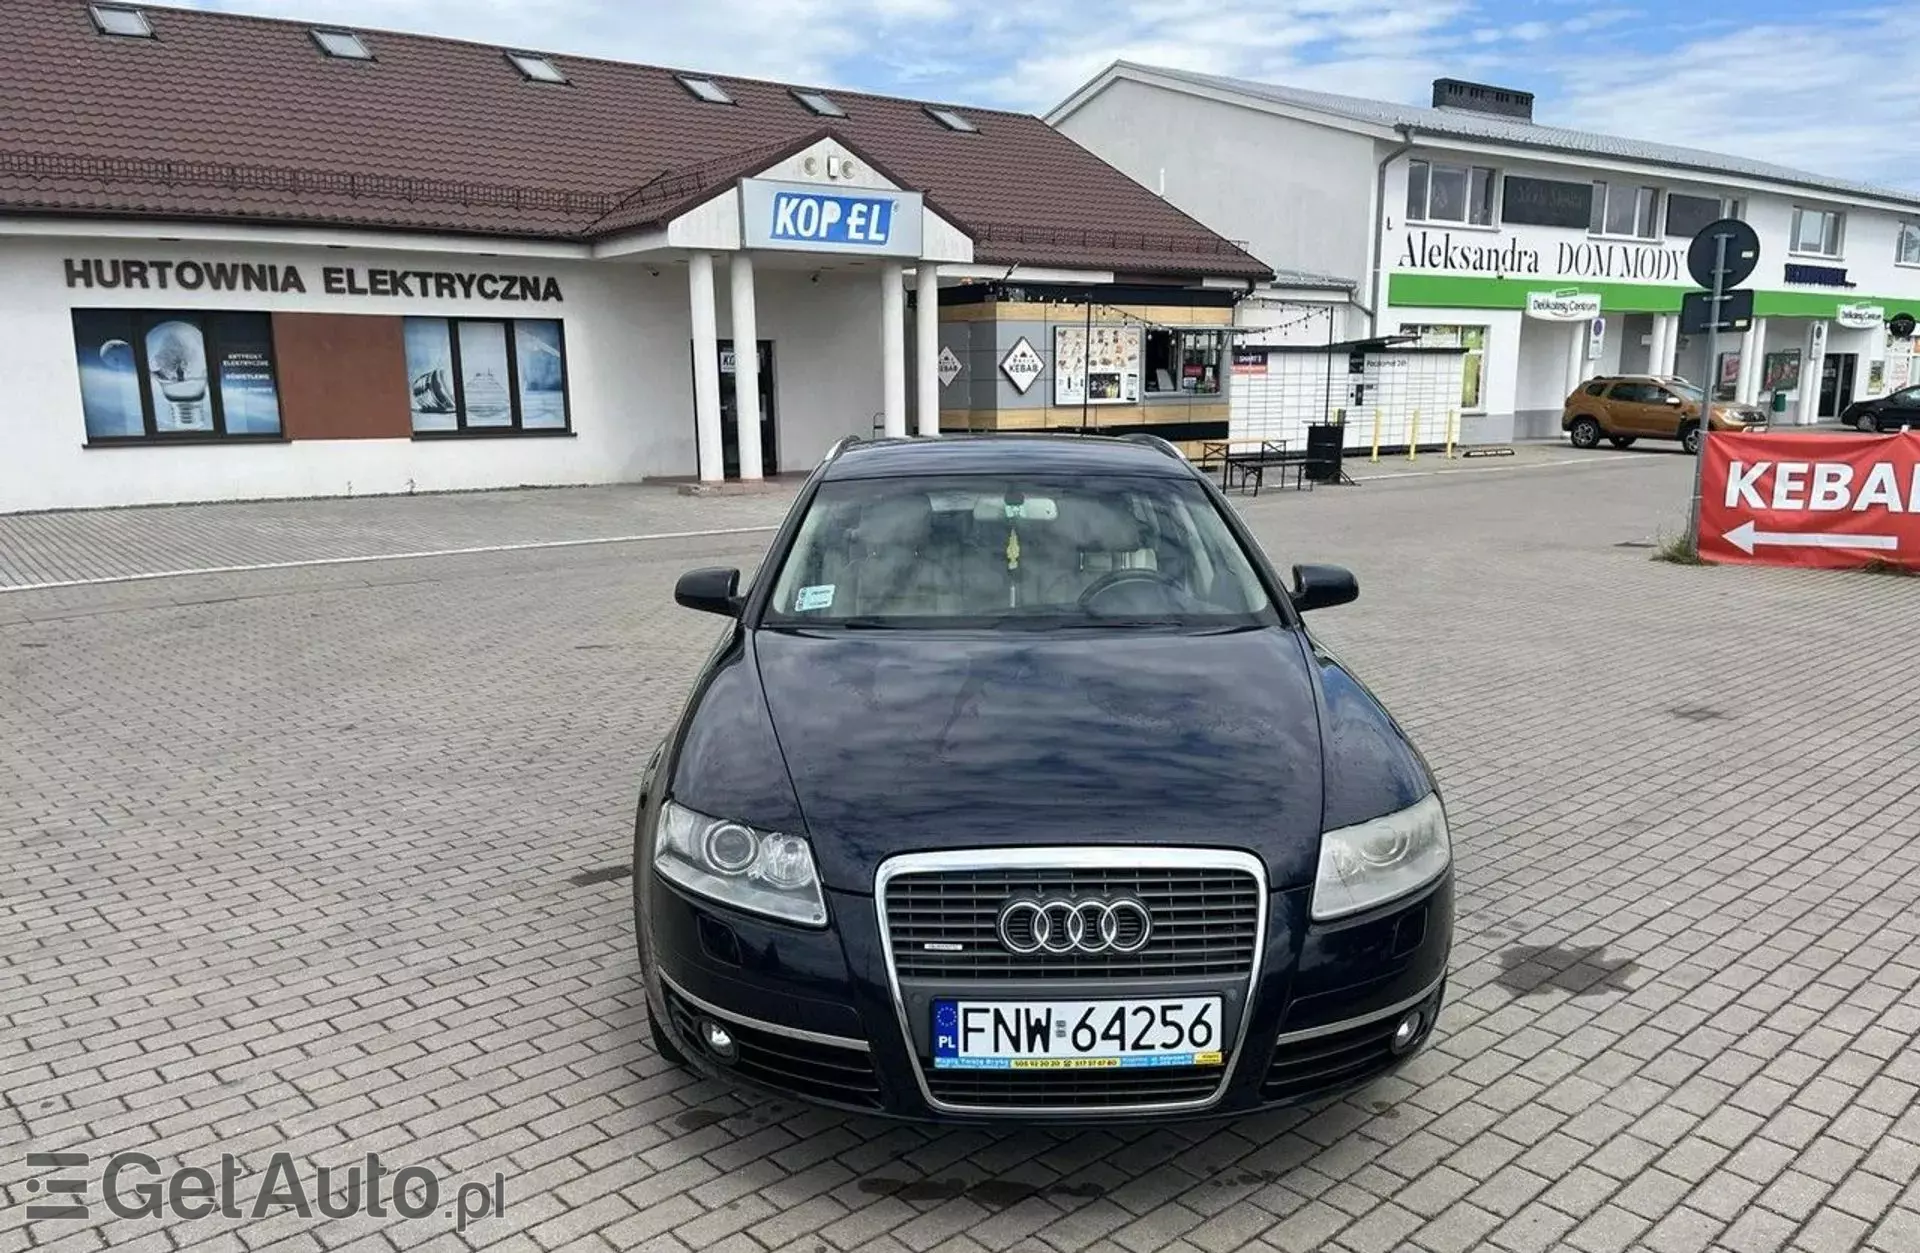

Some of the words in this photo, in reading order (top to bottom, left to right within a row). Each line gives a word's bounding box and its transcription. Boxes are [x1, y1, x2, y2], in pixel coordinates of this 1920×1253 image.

[1398, 231, 1539, 273] Aleksandra
[1556, 241, 1613, 278] DOM
[1620, 246, 1684, 281] MODY
[64, 258, 306, 294] HURTOWNIA
[323, 266, 564, 303] ELEKTRYCZNA
[1009, 363, 1039, 374] KEBAB
[1724, 460, 1920, 513] KEBA
[938, 1036, 956, 1049] PL
[962, 1007, 1052, 1053] FNW
[1071, 1003, 1213, 1052] 64256
